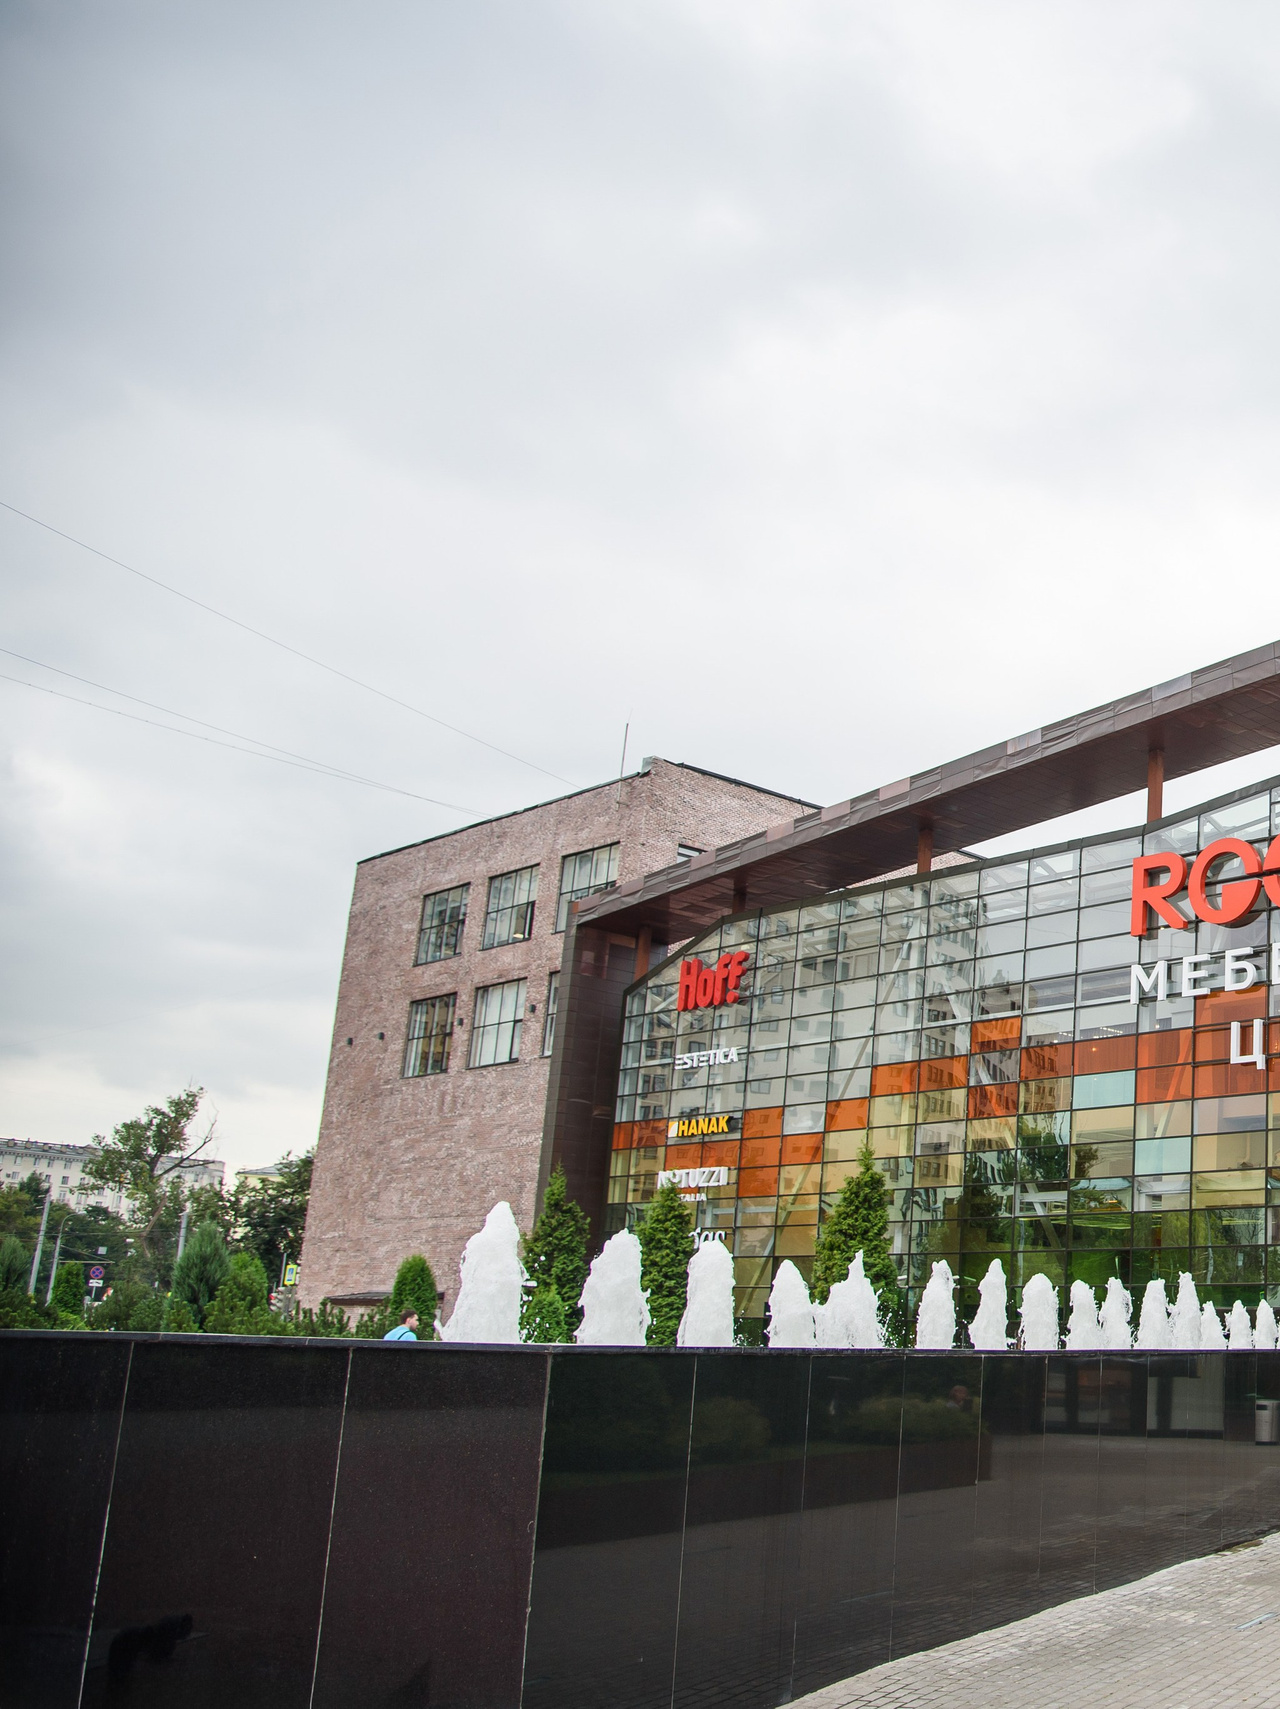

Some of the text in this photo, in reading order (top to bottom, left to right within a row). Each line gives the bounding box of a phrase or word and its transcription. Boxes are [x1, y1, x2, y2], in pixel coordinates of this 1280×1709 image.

[674, 1047, 738, 1070] ESTETICA
[678, 1115, 730, 1137] HANAK
[676, 1193, 707, 1202] TALIA
